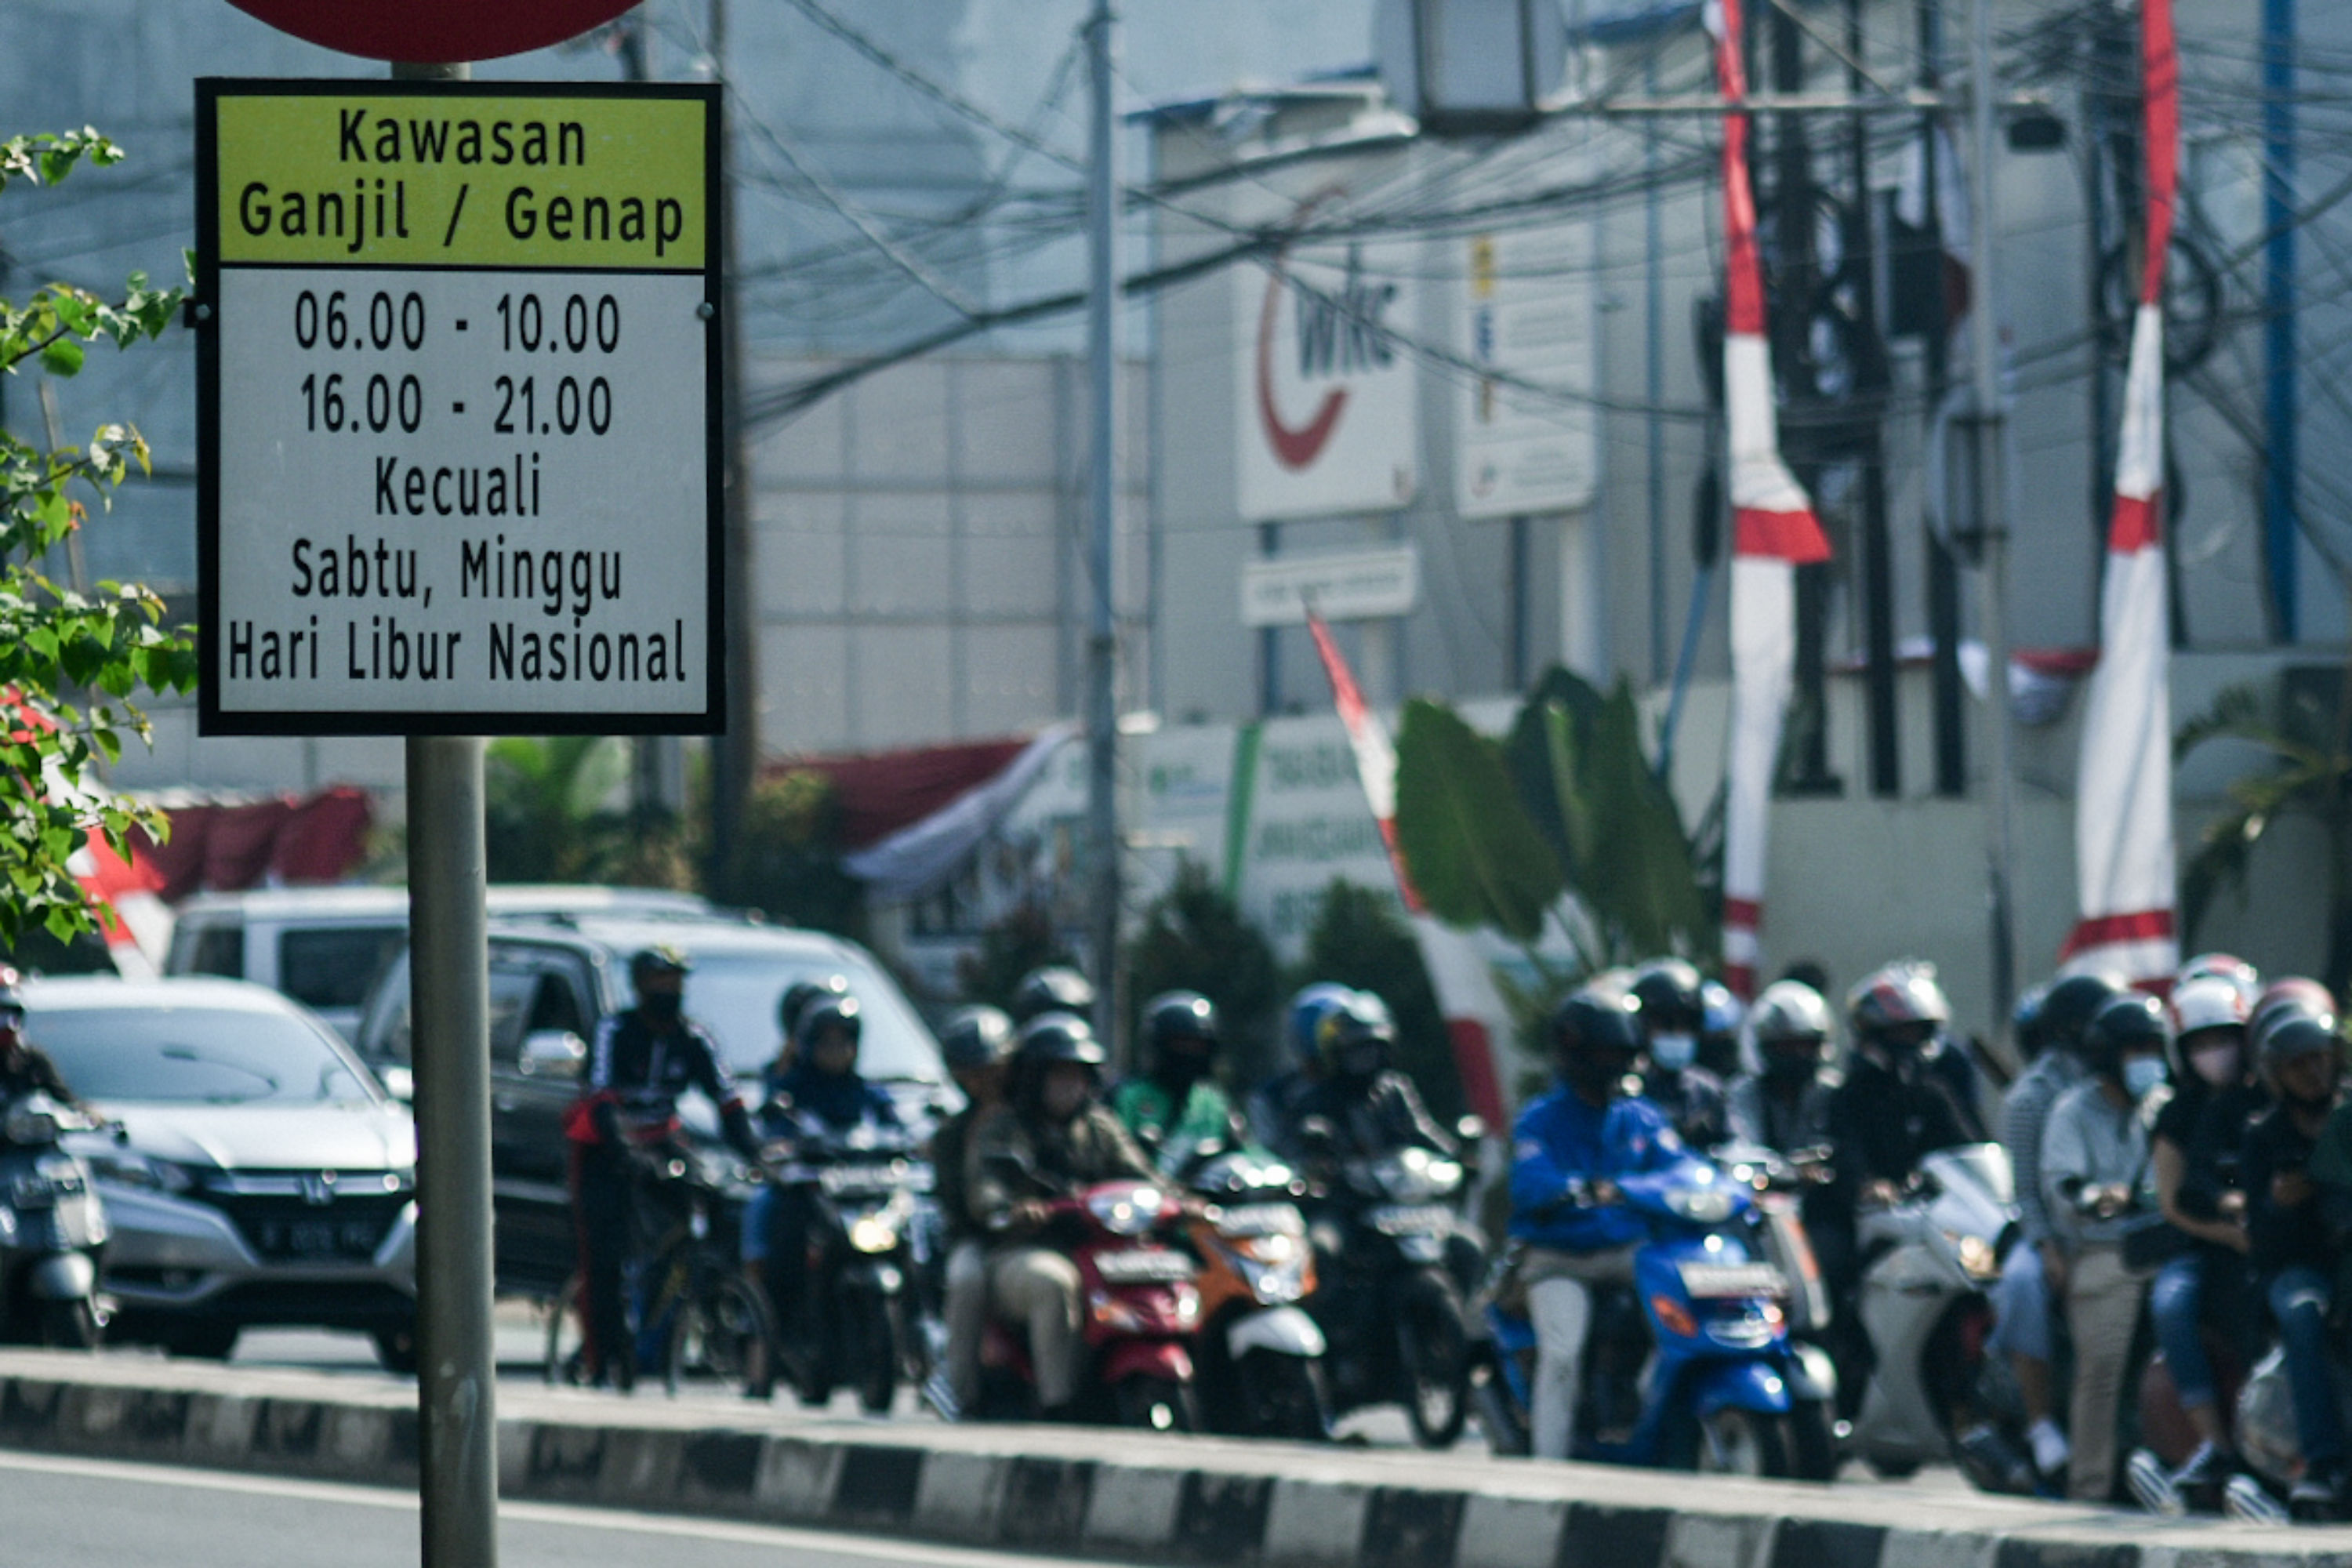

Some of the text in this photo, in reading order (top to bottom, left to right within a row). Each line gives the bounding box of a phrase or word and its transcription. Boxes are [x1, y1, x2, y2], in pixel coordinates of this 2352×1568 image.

[339, 107, 585, 166] Kawasan
[239, 177, 683, 258] Ganjil / Genap
[295, 289, 619, 354] 06.00 - 10.00
[300, 373, 612, 436] 16.00 - 21.00
[376, 452, 541, 517] Kecuali
[292, 533, 622, 616] Sabtu, Minggu
[229, 614, 687, 682] Hari Libur Nasional
